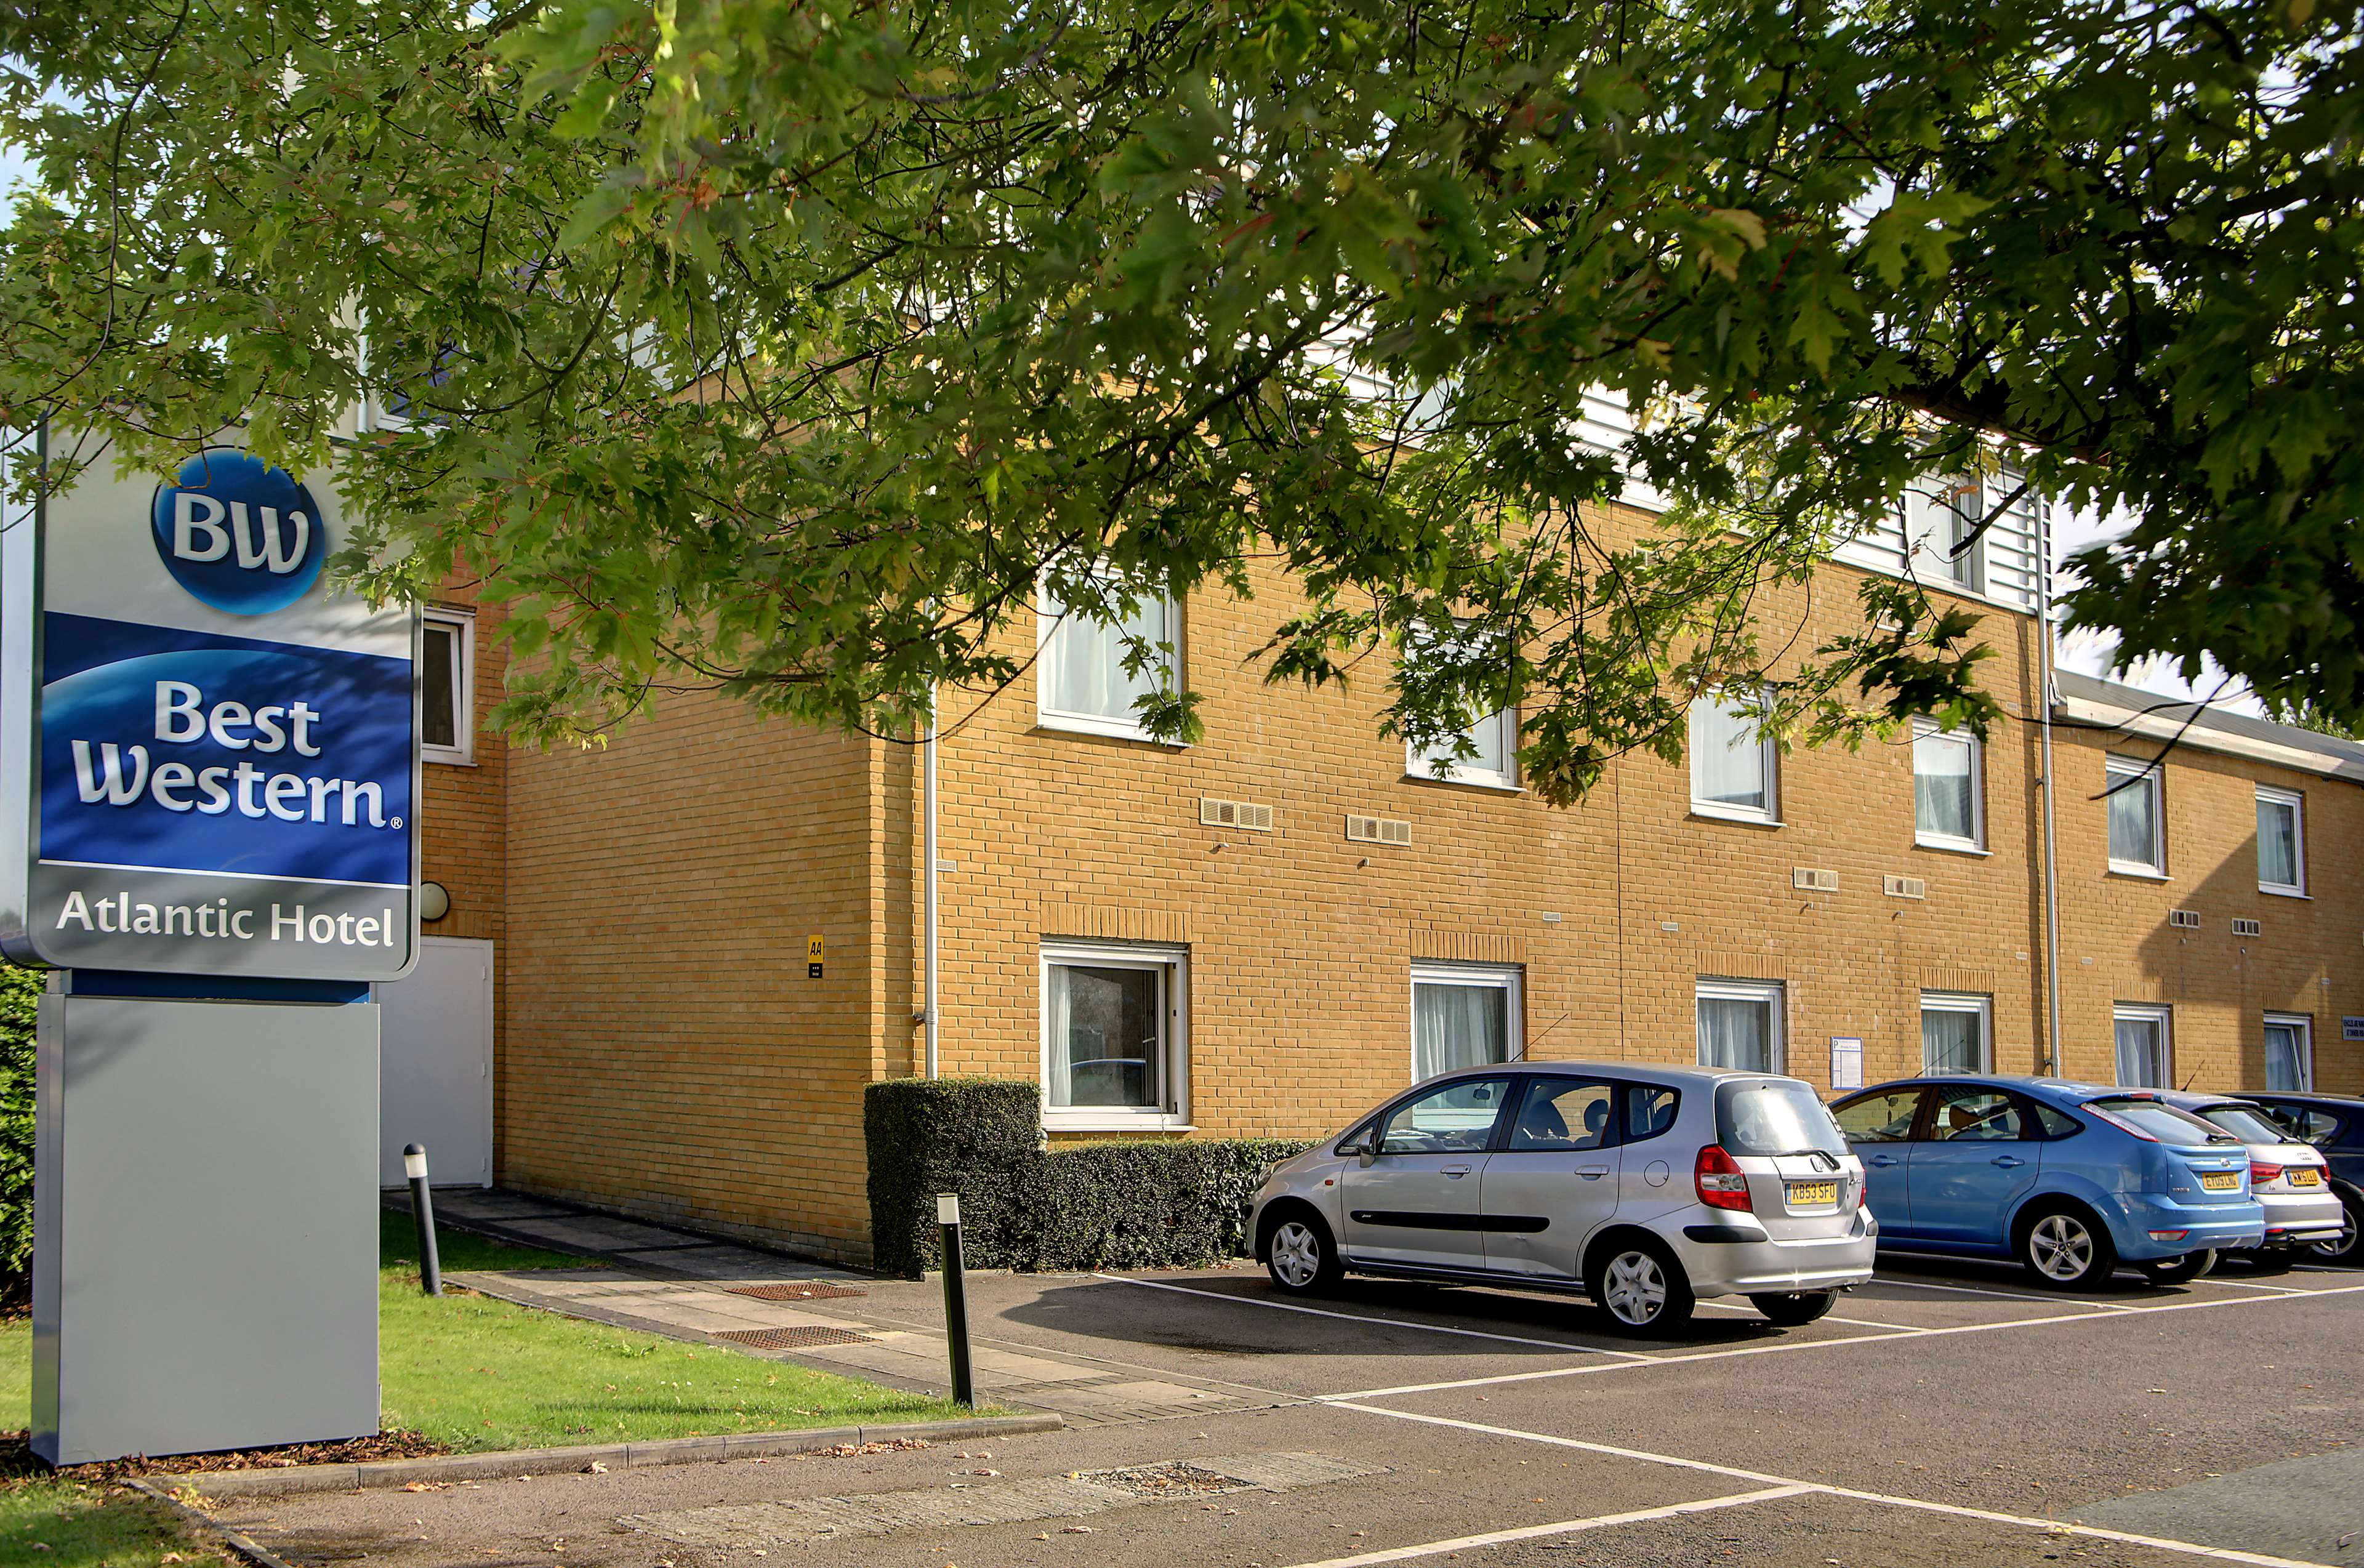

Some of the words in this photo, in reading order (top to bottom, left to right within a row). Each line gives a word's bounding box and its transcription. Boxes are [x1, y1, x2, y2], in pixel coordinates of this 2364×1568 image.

[173, 493, 309, 574] BW
[155, 680, 321, 757] Best
[56, 890, 254, 939] Atlantic
[271, 904, 394, 947] Hotel
[810, 941, 822, 955] AA
[1833, 1040, 1838, 1049] P
[1793, 1183, 1817, 1200] KB53
[1819, 1183, 1835, 1199] SFO
